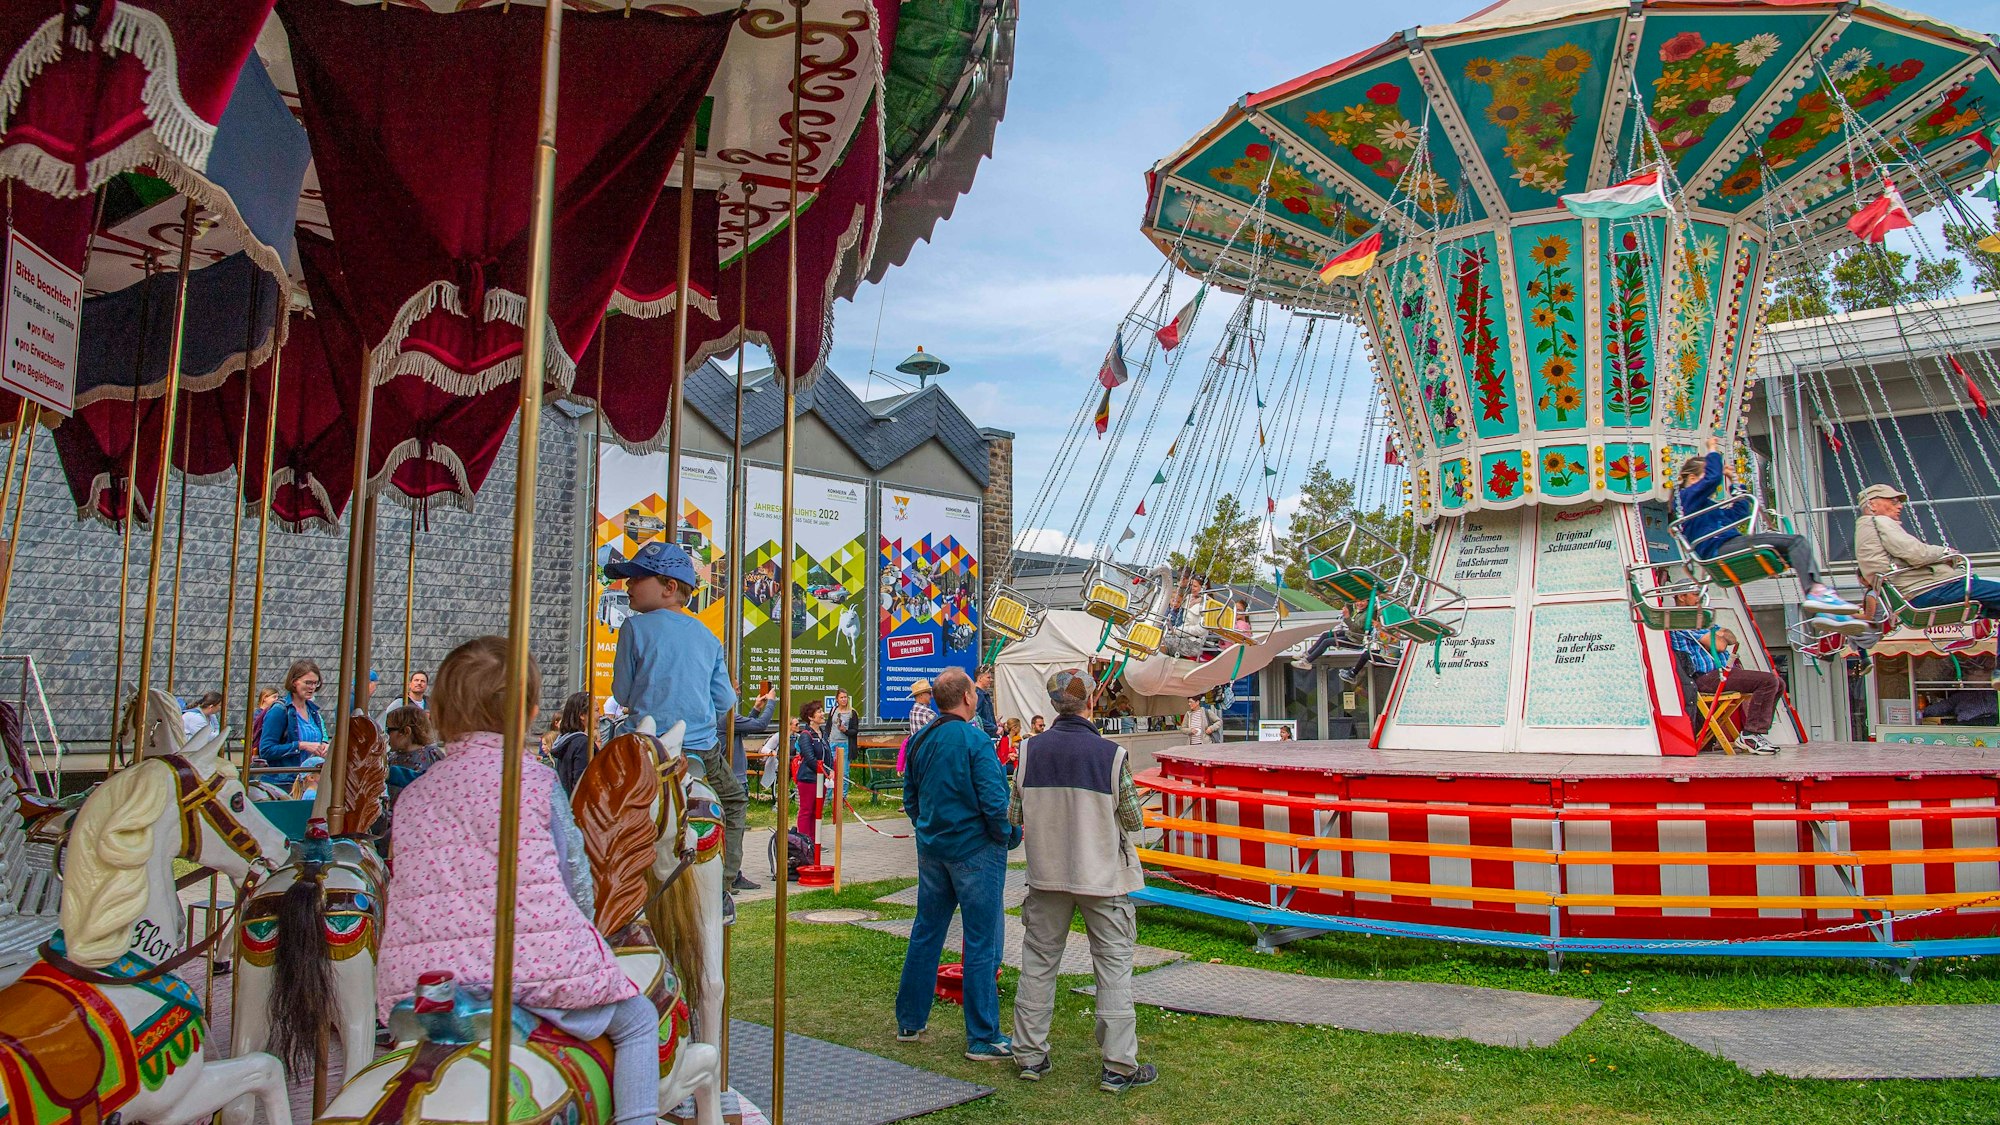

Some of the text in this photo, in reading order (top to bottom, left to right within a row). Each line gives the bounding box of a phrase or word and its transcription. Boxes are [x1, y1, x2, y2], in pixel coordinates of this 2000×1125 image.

[16, 259, 35, 286] Bitte
[37, 273, 71, 308] beachten
[23, 292, 32, 306] eine
[33, 298, 45, 314] Fahrt
[31, 323, 55, 344] pro Kind
[20, 340, 65, 371] pro Erwachsener
[16, 361, 64, 392] pro Begleitperson
[681, 466, 705, 474] KOMMERN
[818, 508, 839, 521] 2022
[1468, 523, 1483, 532] Das
[1556, 529, 1593, 542] Original
[1474, 544, 1509, 554] Flaschen
[1471, 557, 1508, 567] Schirmen
[1466, 569, 1502, 578] Verboten
[1557, 632, 1603, 643] Fahrchips
[891, 639, 919, 648] MITMACHEN
[1570, 643, 1587, 653] der
[1587, 642, 1616, 652] Kasse
[791, 648, 816, 656] ERRÜCKTES
[900, 646, 924, 655] ERLEBEN!
[1426, 659, 1489, 668] Klin und Gross
[1555, 653, 1586, 664] lösen!
[130, 919, 180, 961] Flor
